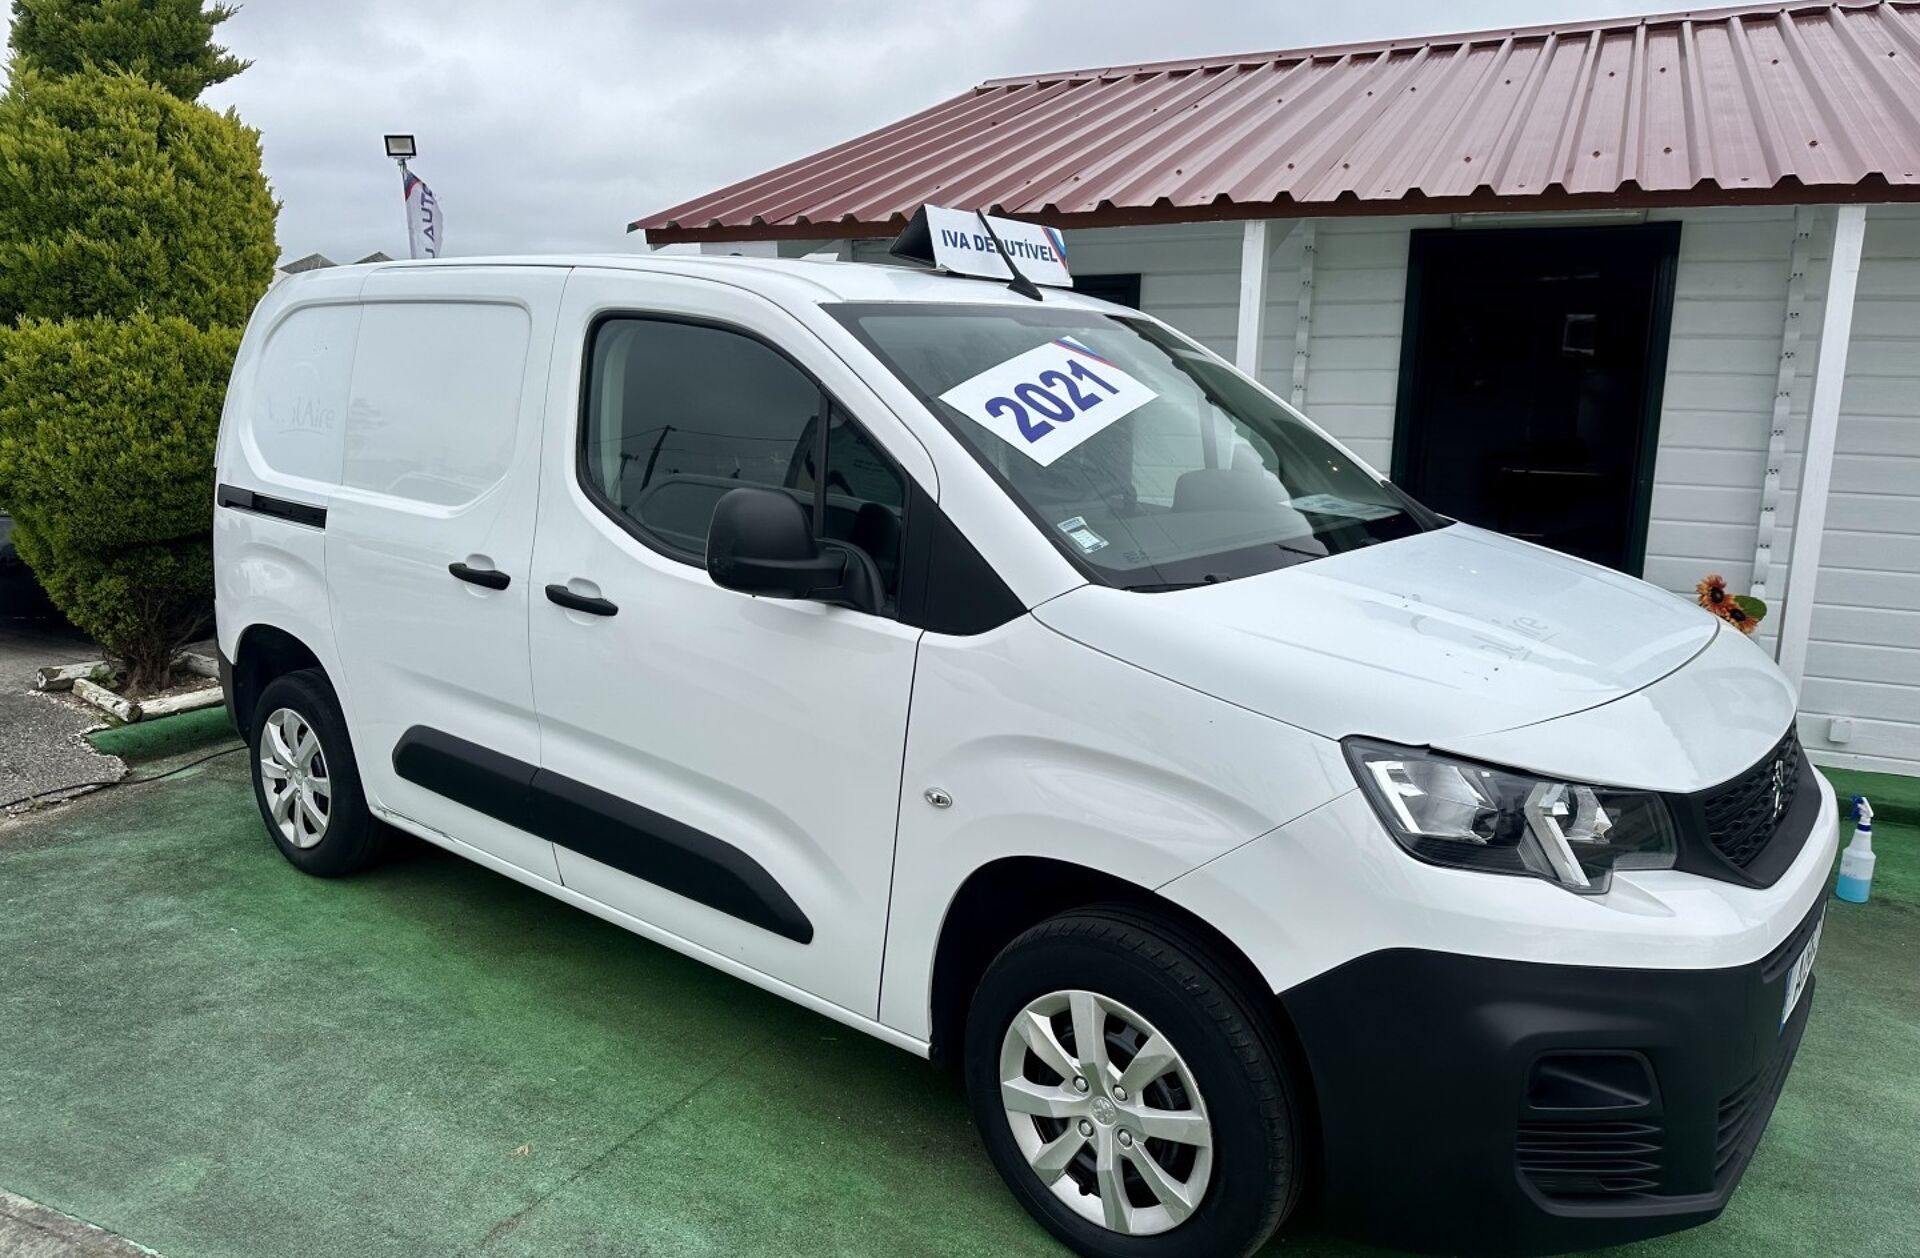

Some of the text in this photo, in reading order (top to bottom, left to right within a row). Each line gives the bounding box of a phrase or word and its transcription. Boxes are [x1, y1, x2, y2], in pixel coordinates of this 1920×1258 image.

[941, 229, 1058, 263] IVA DEUTÍVEL
[985, 359, 1120, 443] 2021
